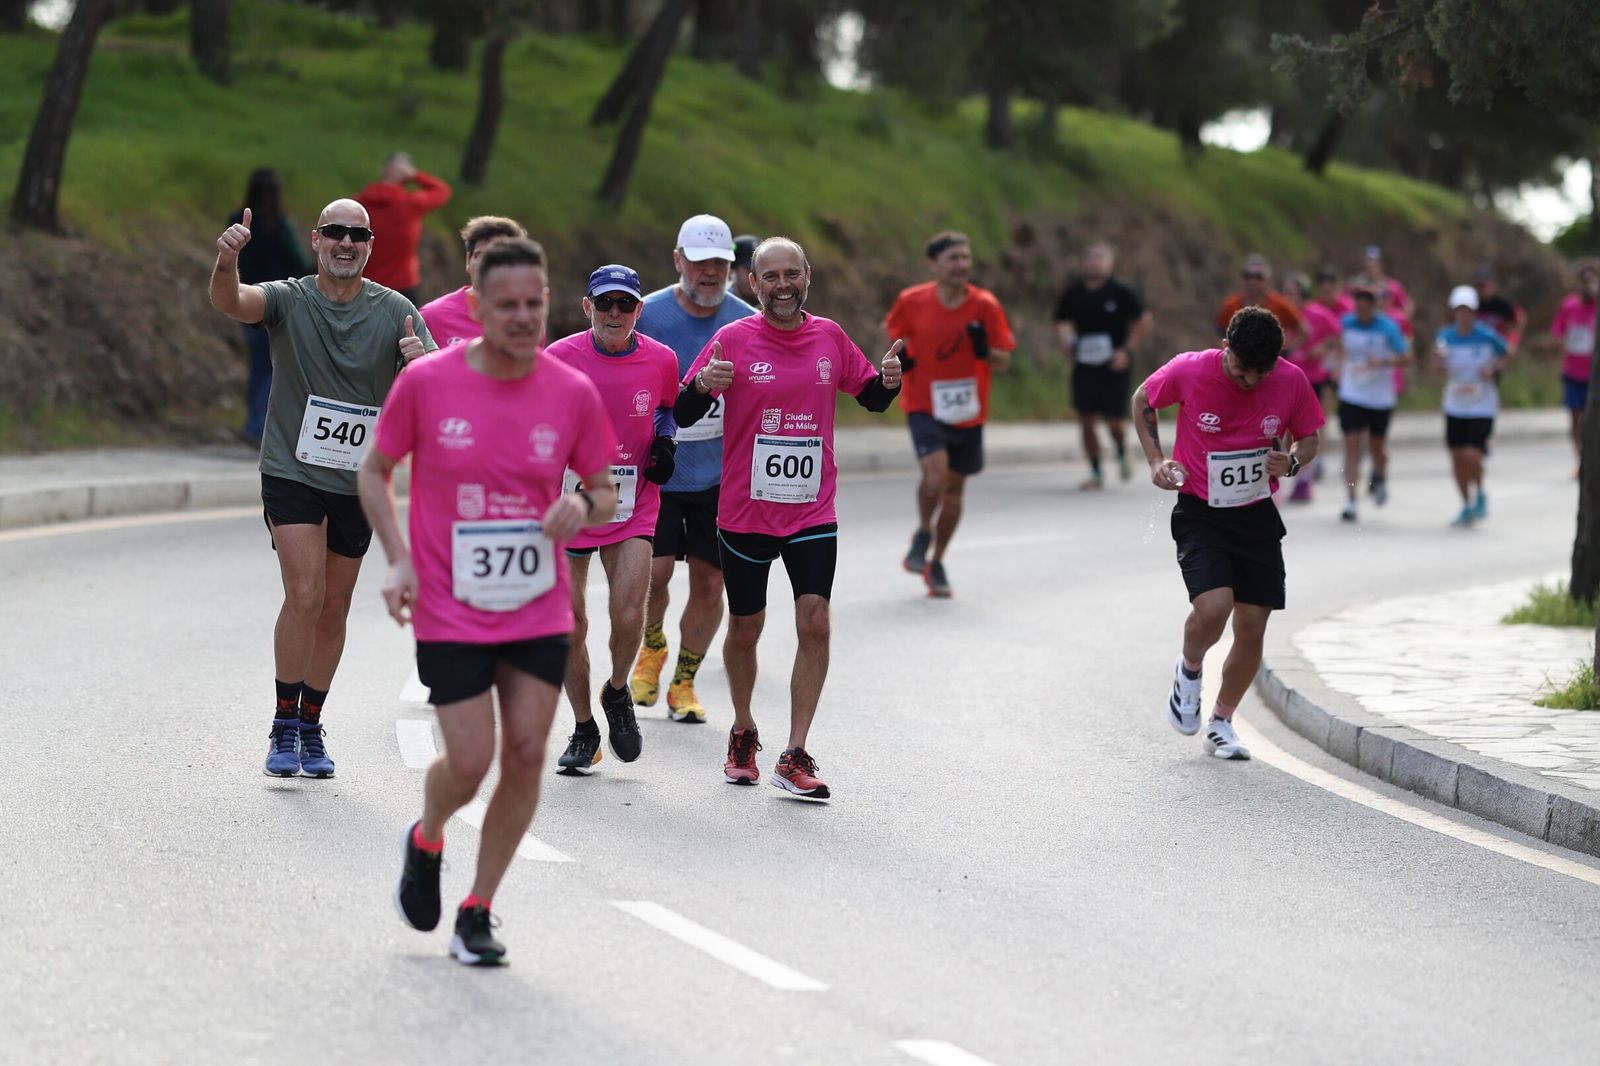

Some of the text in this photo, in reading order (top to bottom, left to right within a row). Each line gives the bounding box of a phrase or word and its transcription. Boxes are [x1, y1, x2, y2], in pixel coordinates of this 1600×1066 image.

[784, 422, 794, 430] de
[785, 413, 813, 421] Ciudad
[313, 416, 366, 447] 540
[765, 454, 814, 479] 600
[1220, 462, 1263, 487] 615
[472, 545, 540, 578] 370
